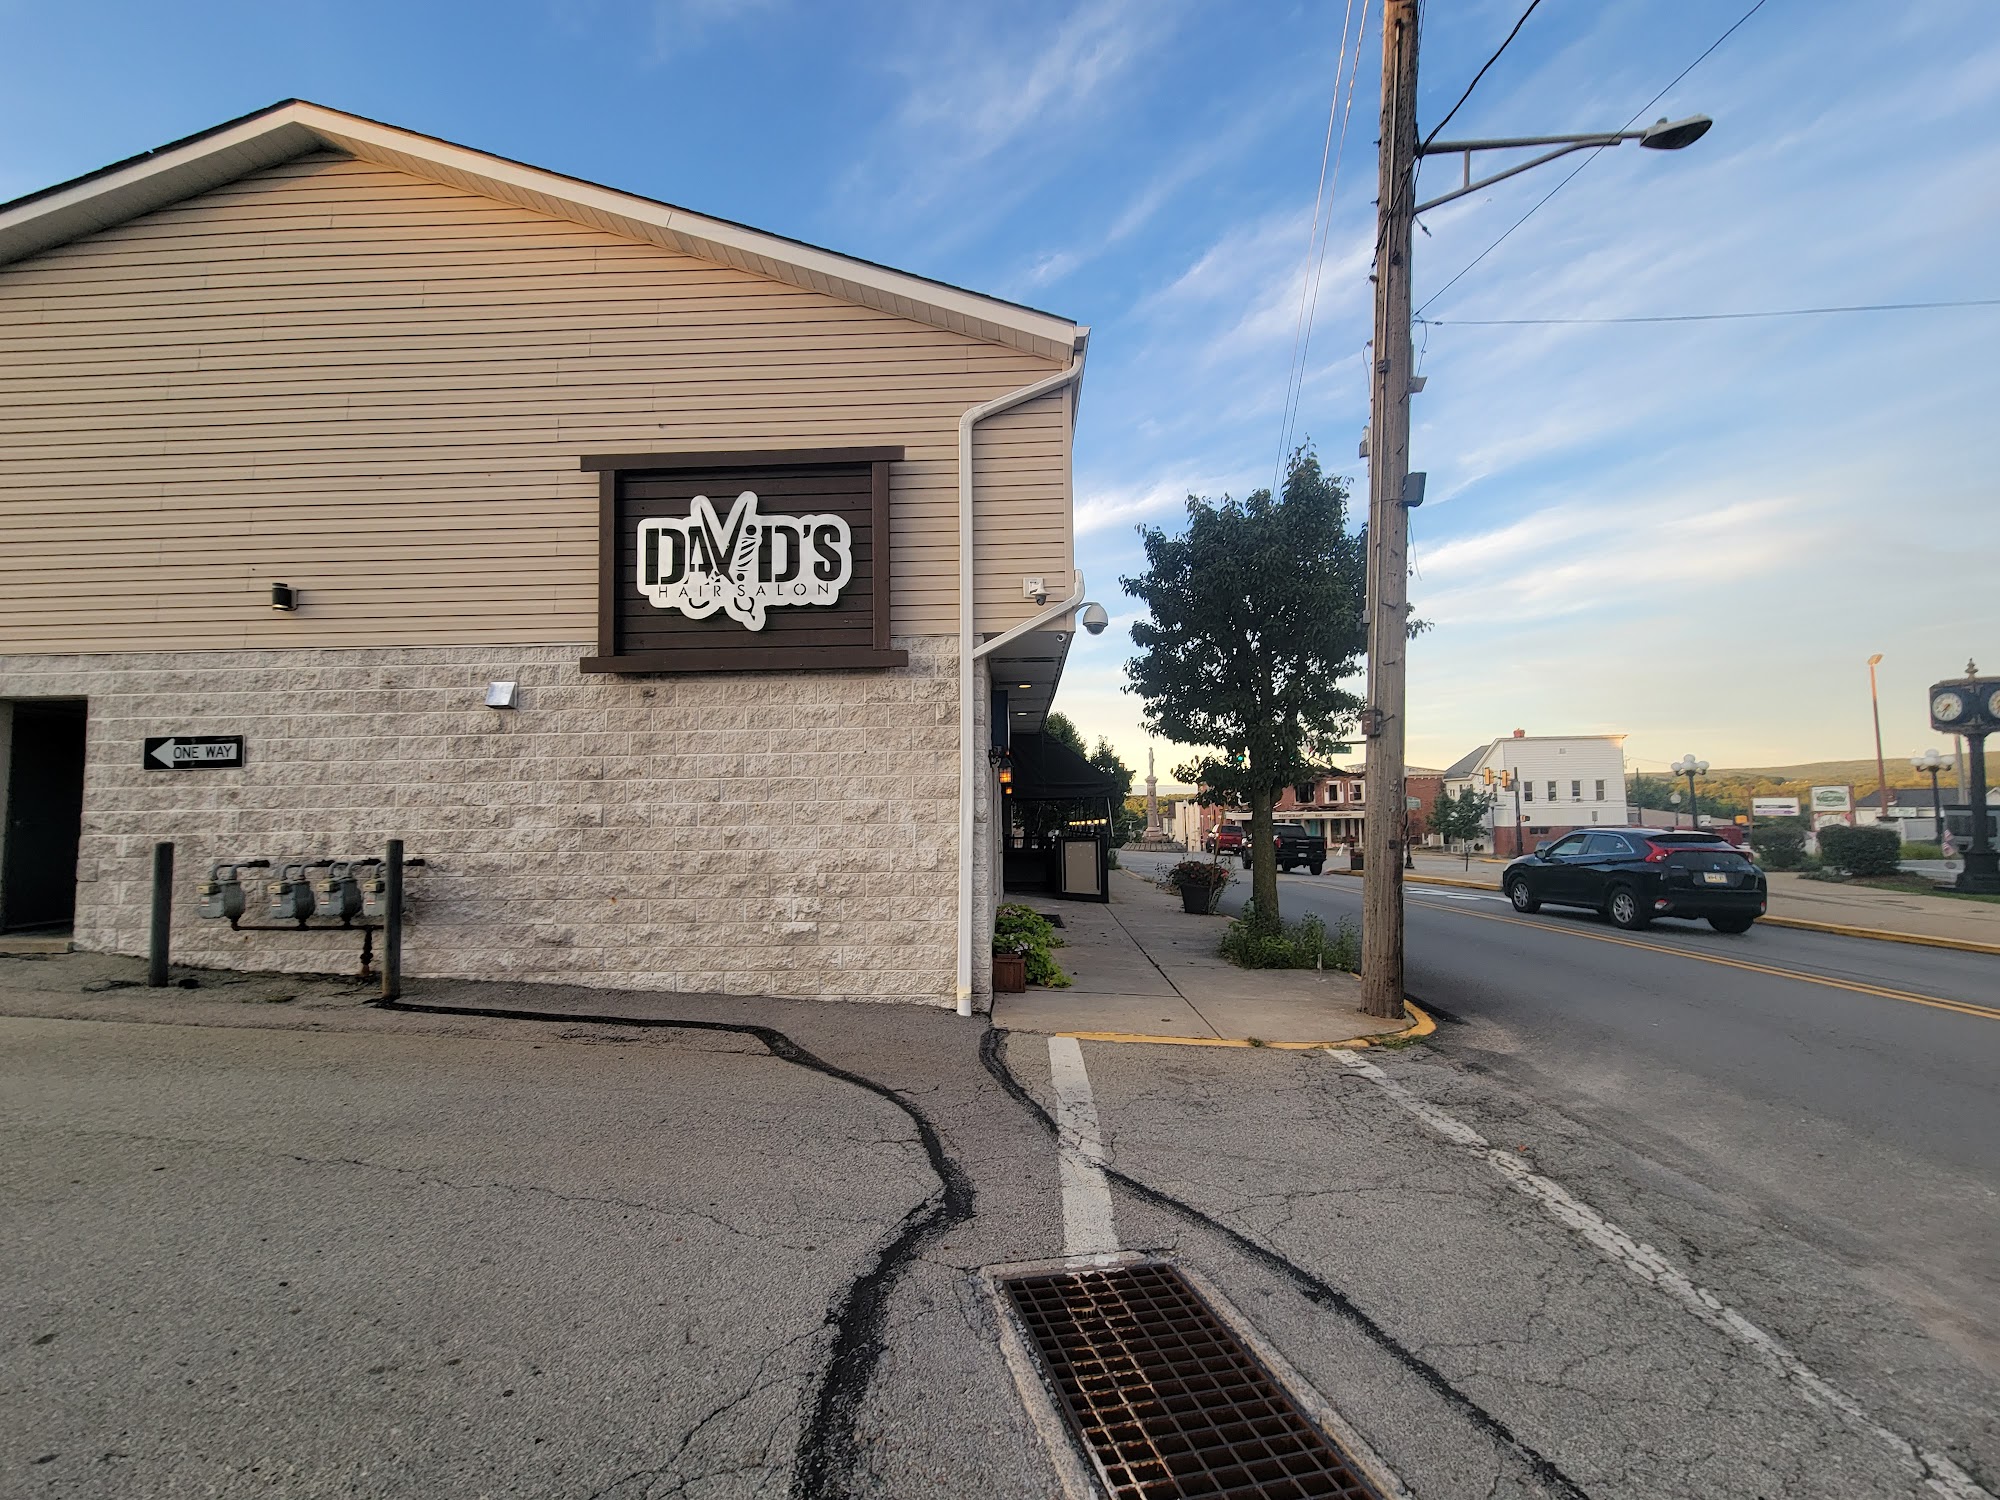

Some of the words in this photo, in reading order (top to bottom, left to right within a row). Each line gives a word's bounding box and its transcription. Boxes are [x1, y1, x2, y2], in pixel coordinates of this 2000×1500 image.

[644, 502, 842, 586] DAVID'S
[657, 584, 722, 599] HAIR
[736, 582, 829, 598] SALON
[173, 746, 199, 759] ONE
[206, 745, 232, 758] WAY
